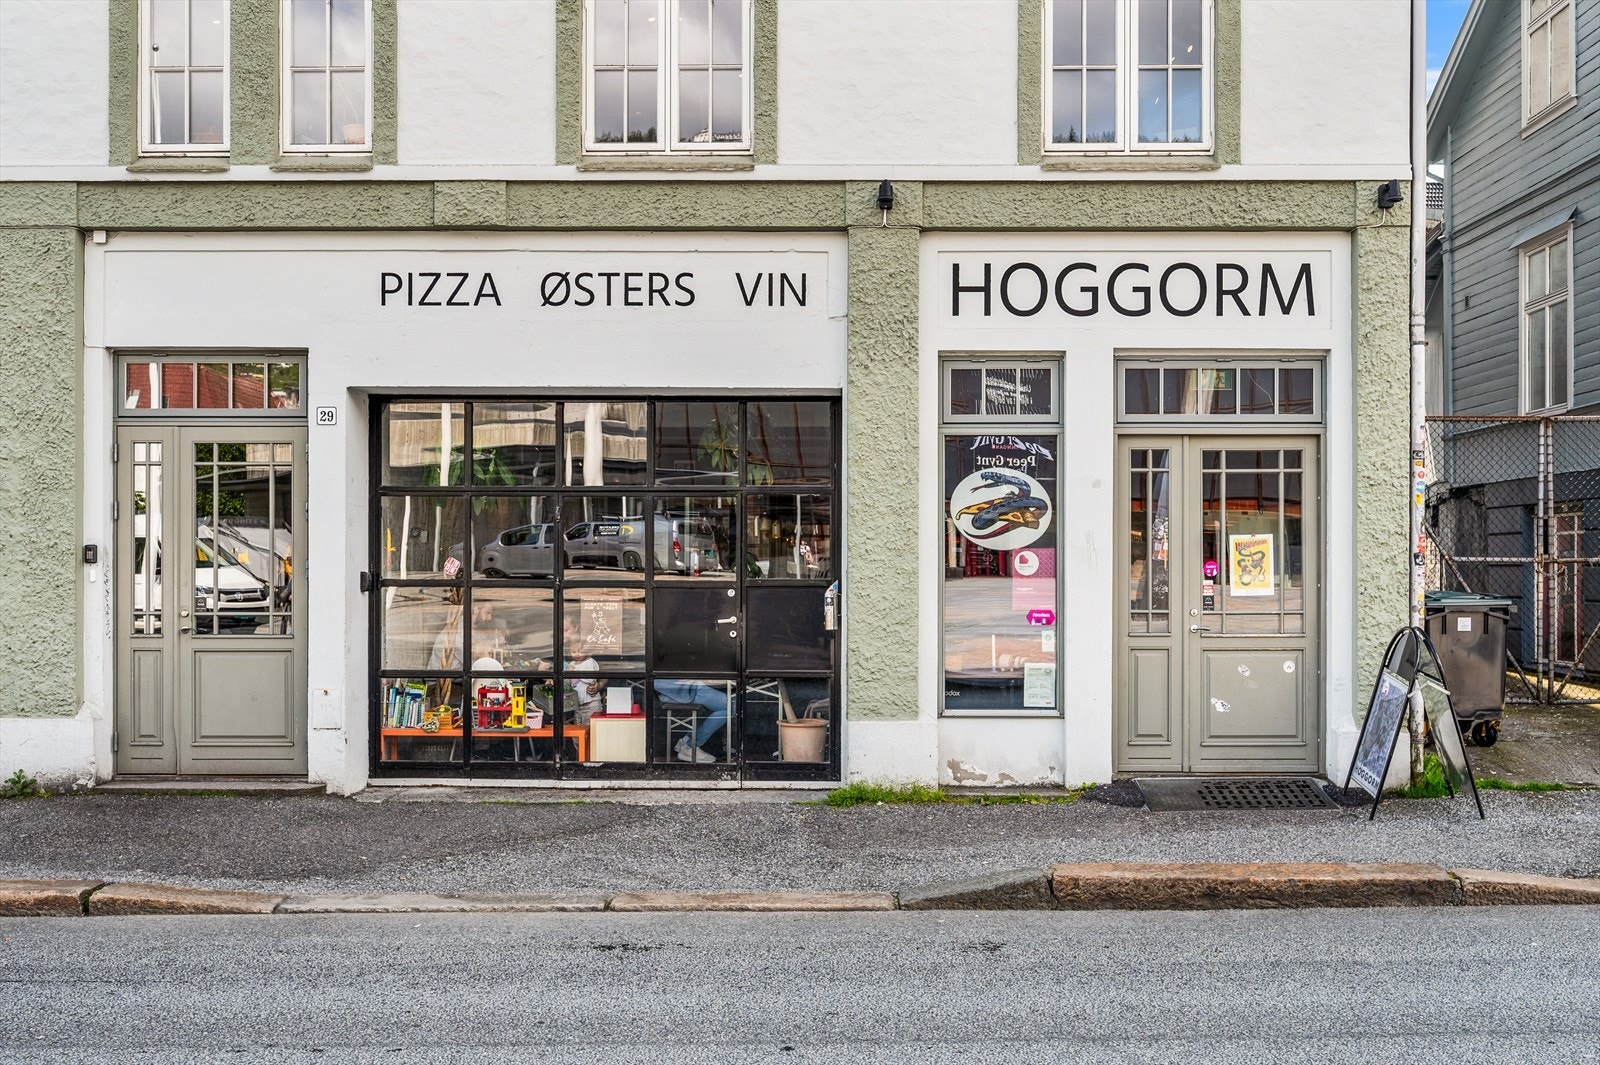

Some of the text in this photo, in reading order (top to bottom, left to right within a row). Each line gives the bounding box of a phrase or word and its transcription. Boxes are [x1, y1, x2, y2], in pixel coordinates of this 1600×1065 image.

[380, 271, 807, 307] PIZZA ØSTERS VIN
[953, 263, 1316, 317] HOGGORM
[319, 410, 334, 422] 29
